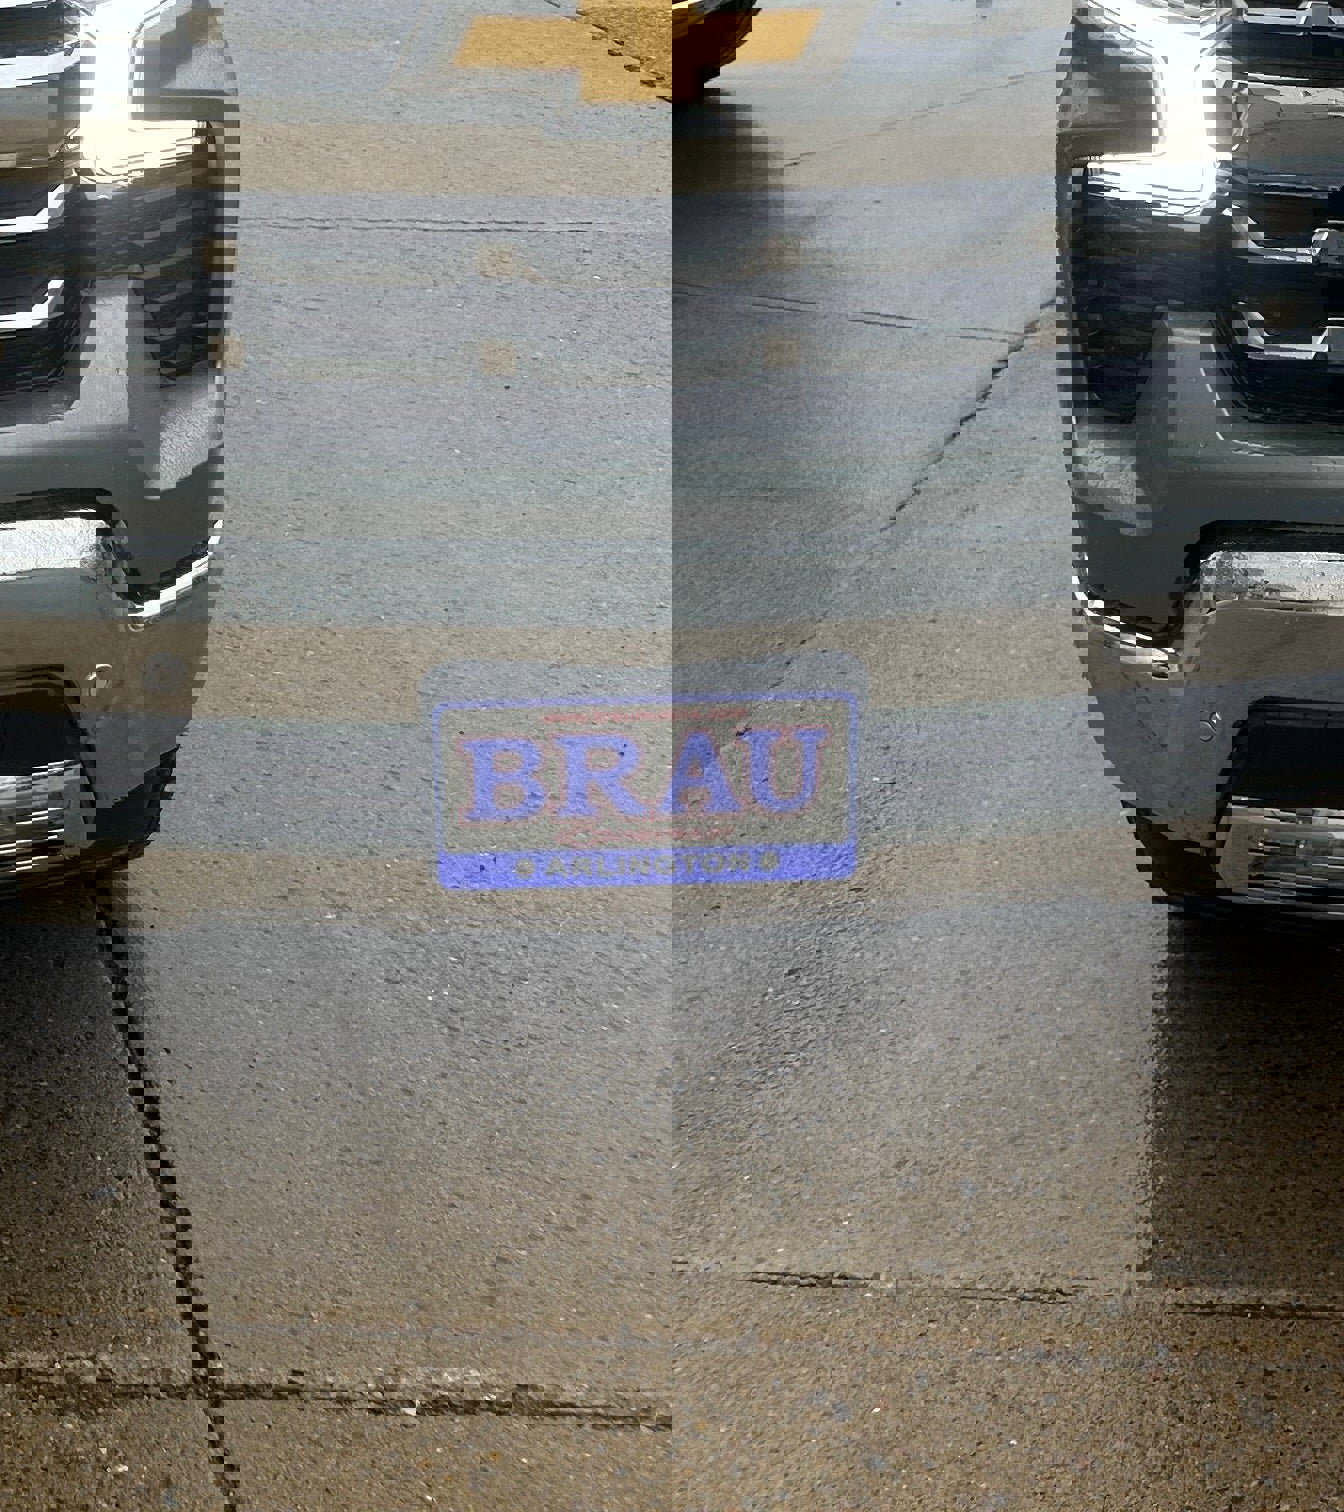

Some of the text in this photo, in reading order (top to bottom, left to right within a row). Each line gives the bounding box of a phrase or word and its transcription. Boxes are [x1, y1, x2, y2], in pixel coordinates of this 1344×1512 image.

[540, 707, 749, 726] www.braumotors.com
[455, 725, 833, 828] BRAU
[612, 826, 737, 844] CHEVROLET
[544, 852, 751, 879] ARLINGTON
